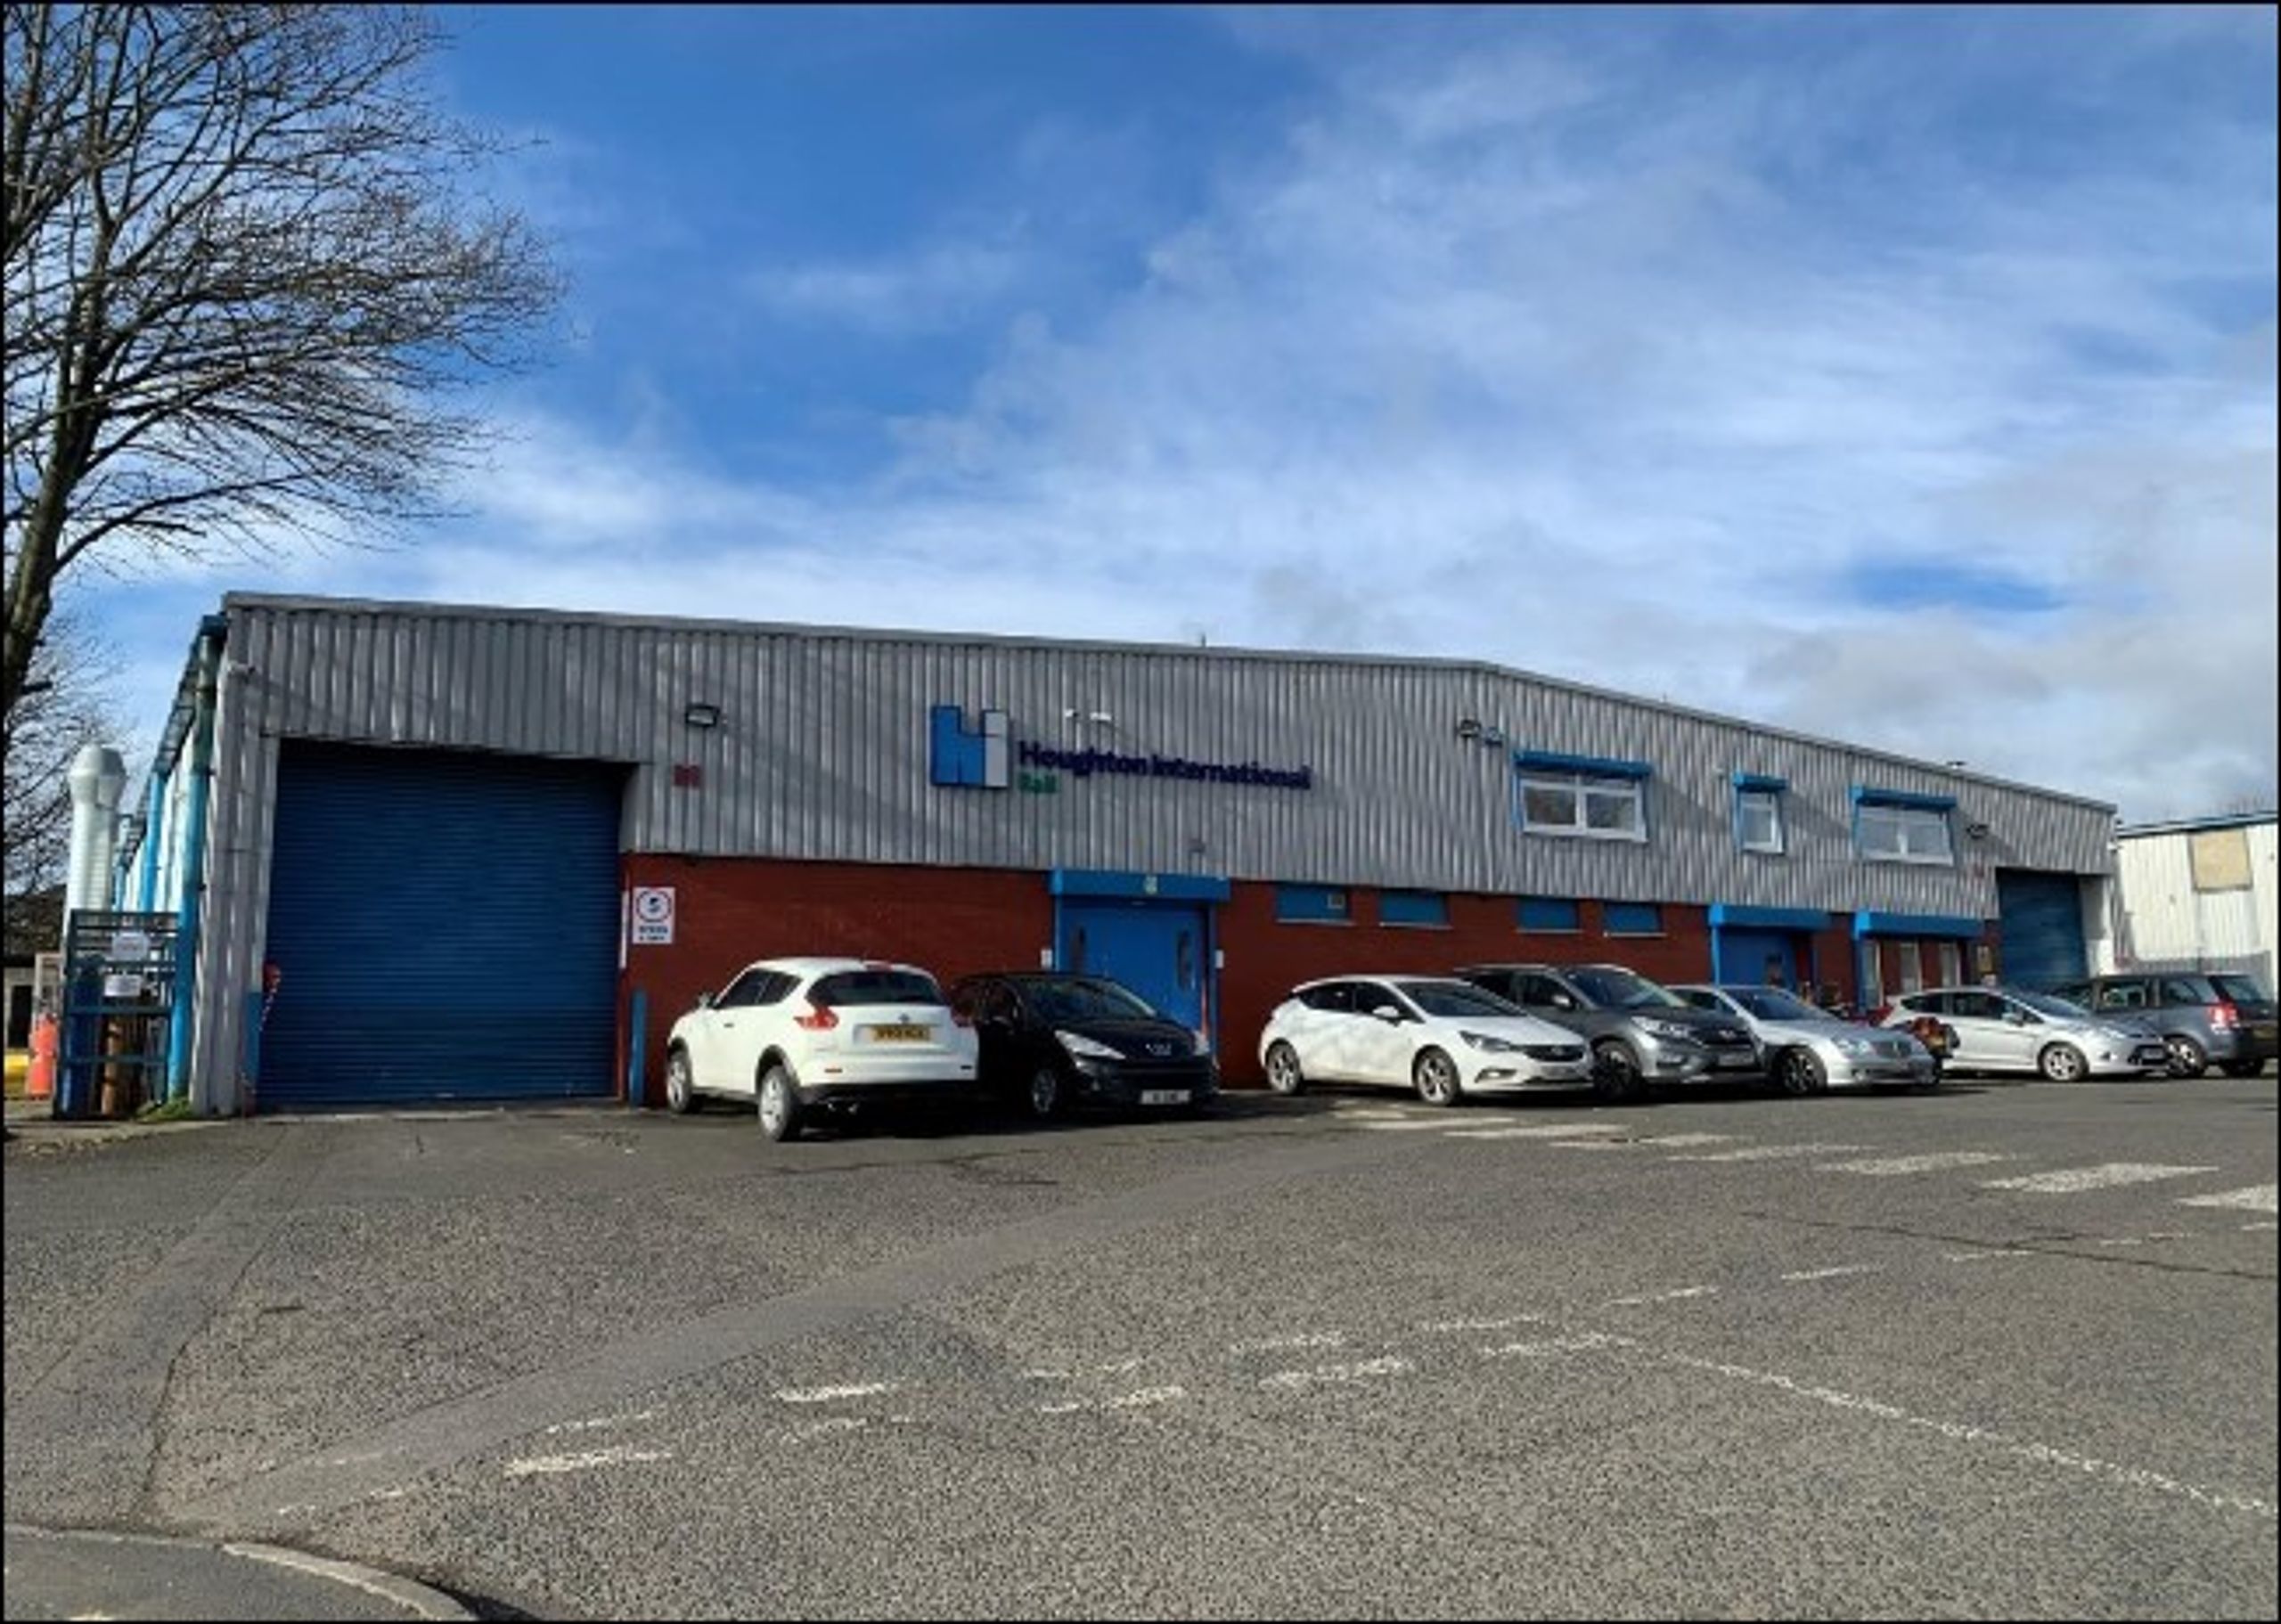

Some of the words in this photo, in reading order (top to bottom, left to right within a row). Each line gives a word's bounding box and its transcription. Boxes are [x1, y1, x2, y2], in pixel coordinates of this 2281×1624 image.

[1018, 740, 1147, 777] Houghton
[1151, 755, 1311, 790] International
[1019, 771, 1058, 793] Rail
